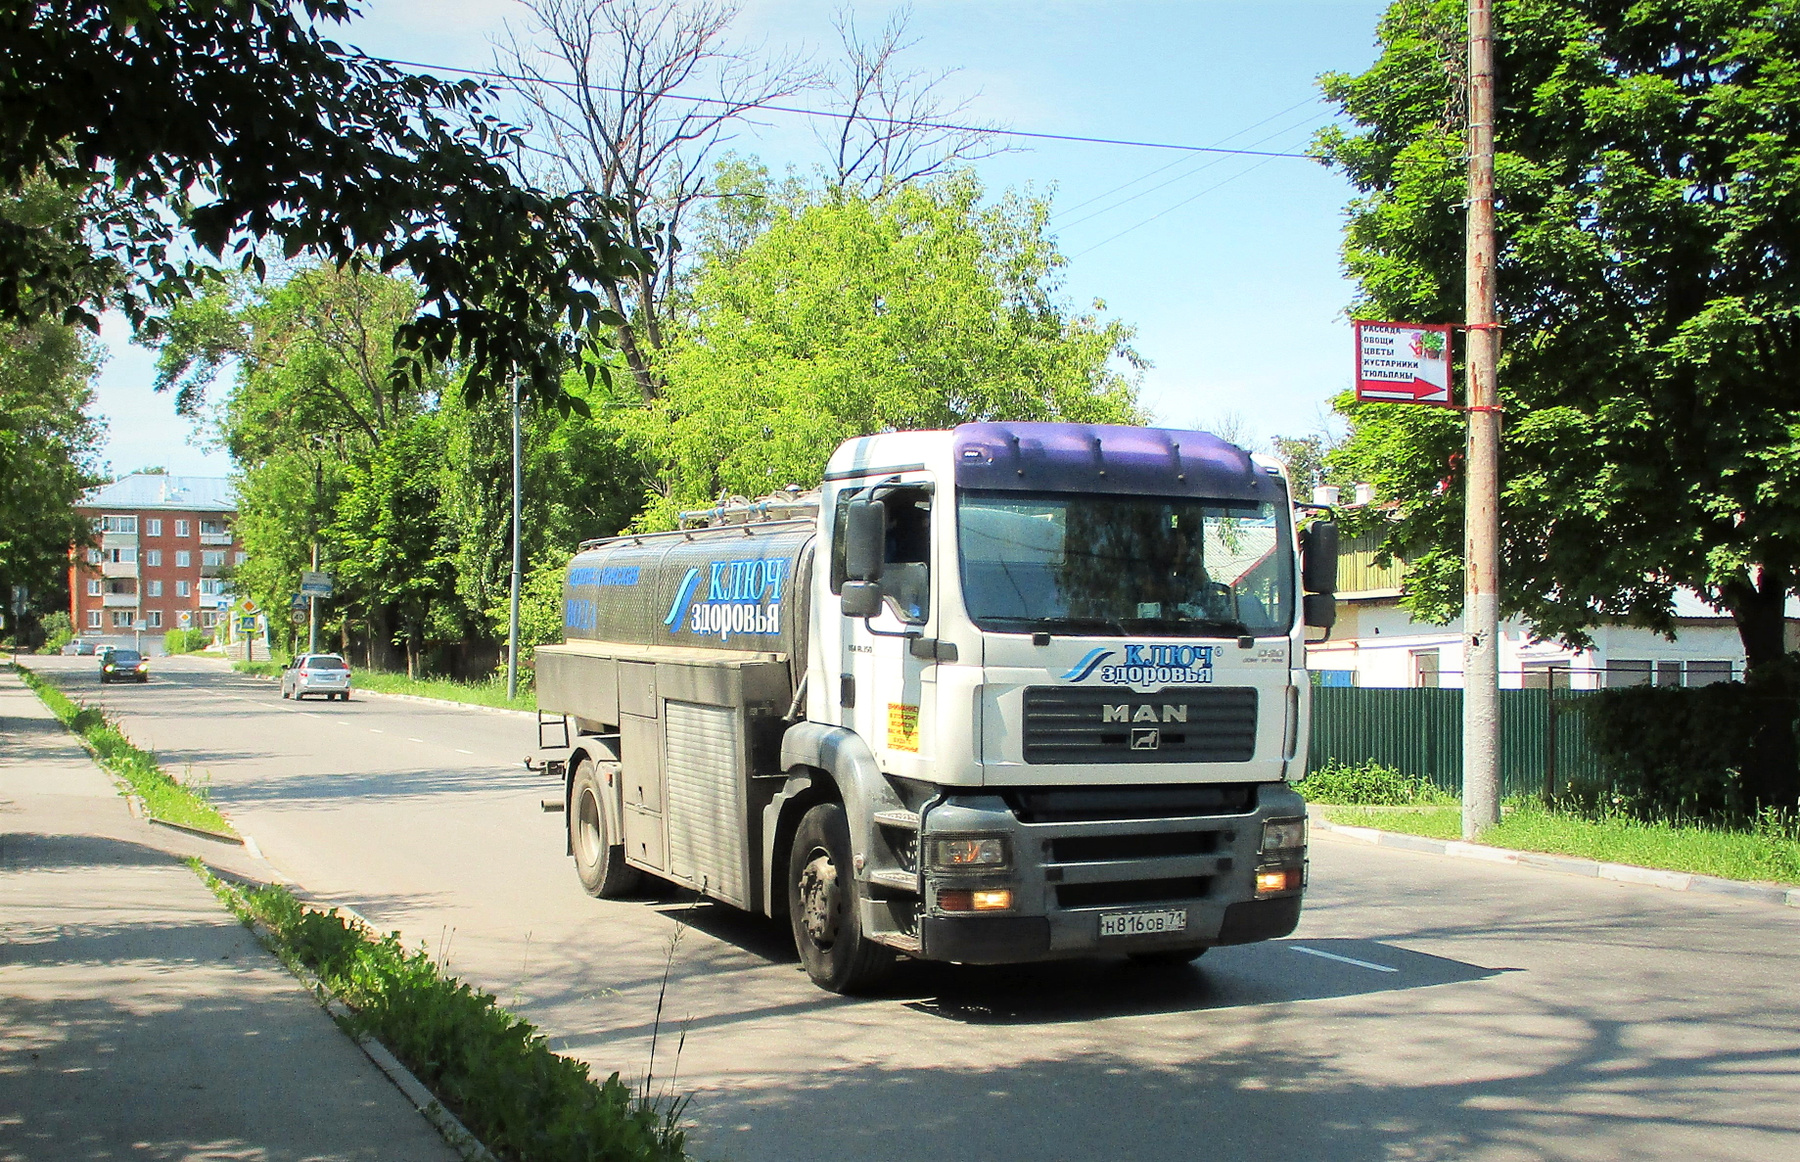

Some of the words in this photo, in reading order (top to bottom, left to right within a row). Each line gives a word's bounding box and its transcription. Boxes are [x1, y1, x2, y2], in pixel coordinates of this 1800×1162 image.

[1363, 325, 1401, 334] РАССАДА
[1363, 336, 1394, 346] ОВОЩИ
[1363, 347, 1395, 356] ЦВЕТЫ
[1363, 358, 1419, 369] КУСТАРНИКИ
[1363, 369, 1413, 379] ТЮЛЬПАНЫ
[708, 559, 785, 601] КЛЮЧ
[1123, 645, 1214, 668] КЛЮЧ
[1102, 704, 1188, 723] MAN
